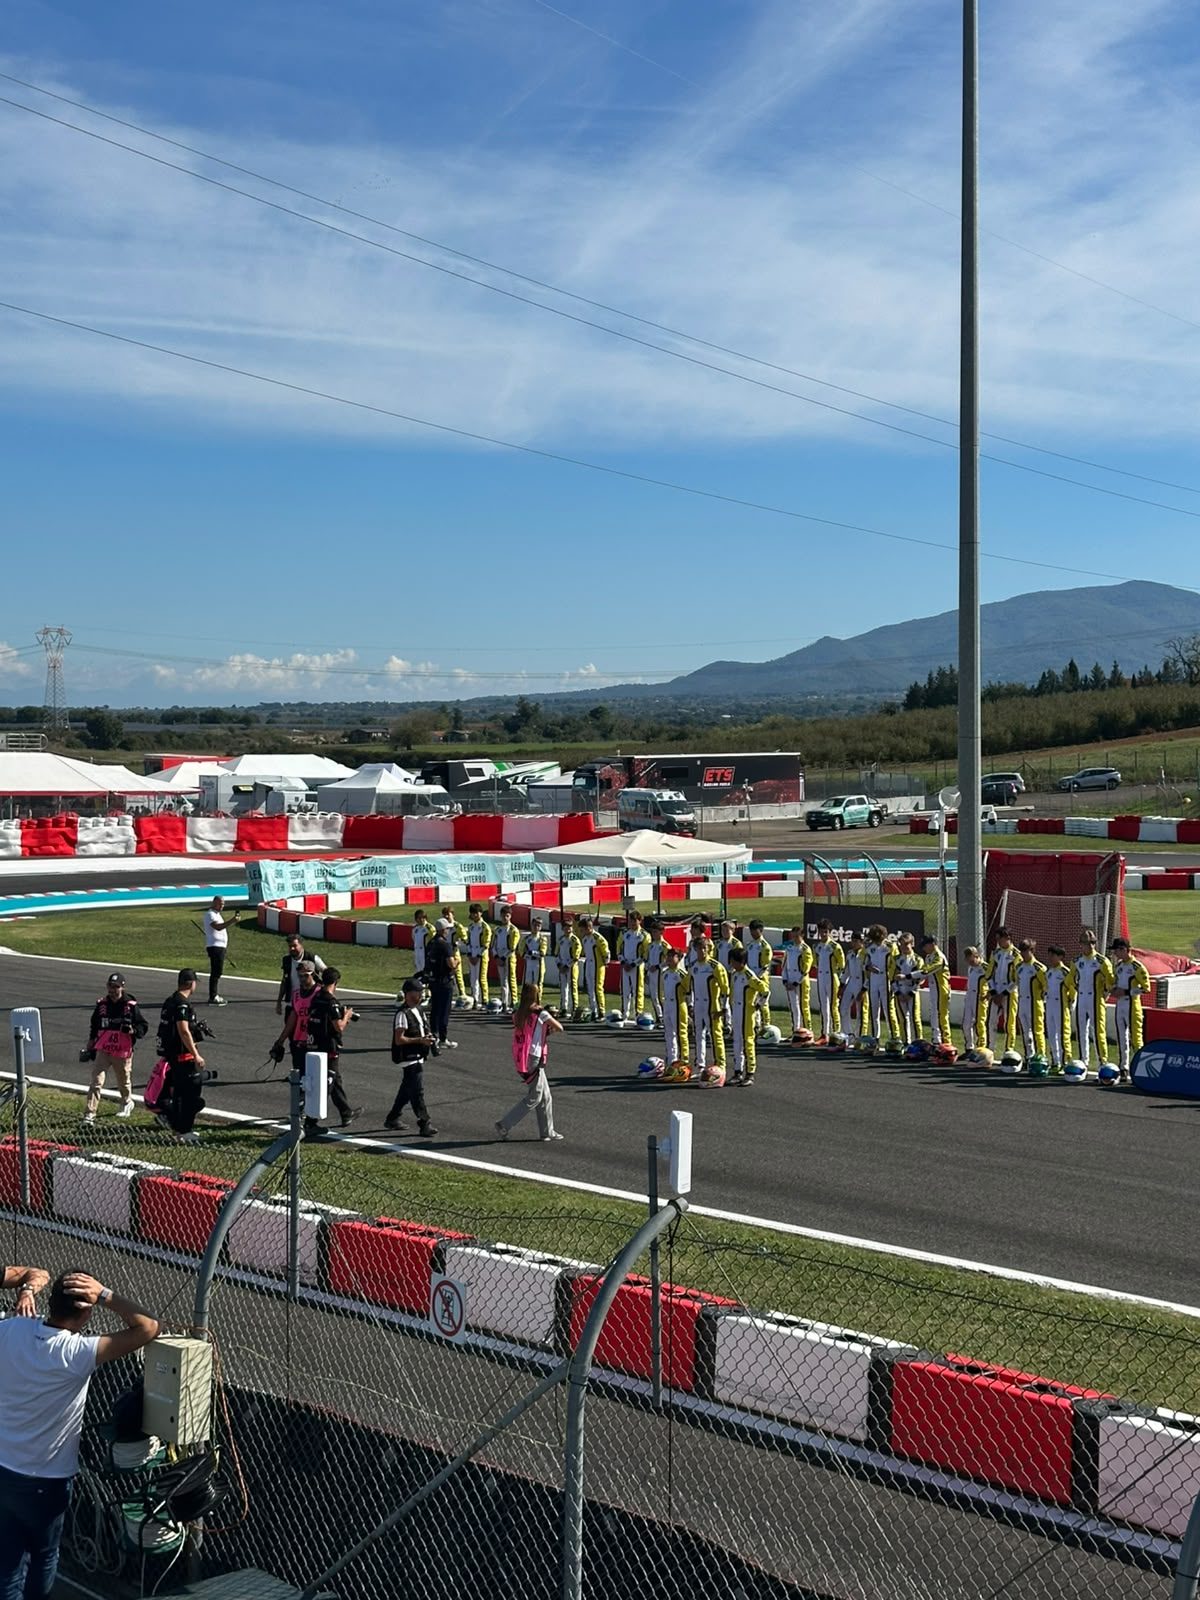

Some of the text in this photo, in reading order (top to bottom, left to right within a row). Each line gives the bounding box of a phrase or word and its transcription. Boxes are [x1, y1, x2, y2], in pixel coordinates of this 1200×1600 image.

[705, 768, 732, 782] ETS
[360, 866, 387, 876] LEOPARD
[411, 864, 437, 873] LEOPARD
[460, 862, 486, 872] LEOPARD
[510, 861, 535, 871] LEOPARD
[413, 876, 437, 885] VITERBO
[463, 875, 486, 884] VITERBO
[512, 873, 535, 882] VITERBO
[361, 878, 387, 888] VITERBO
[829, 926, 853, 942] eta
